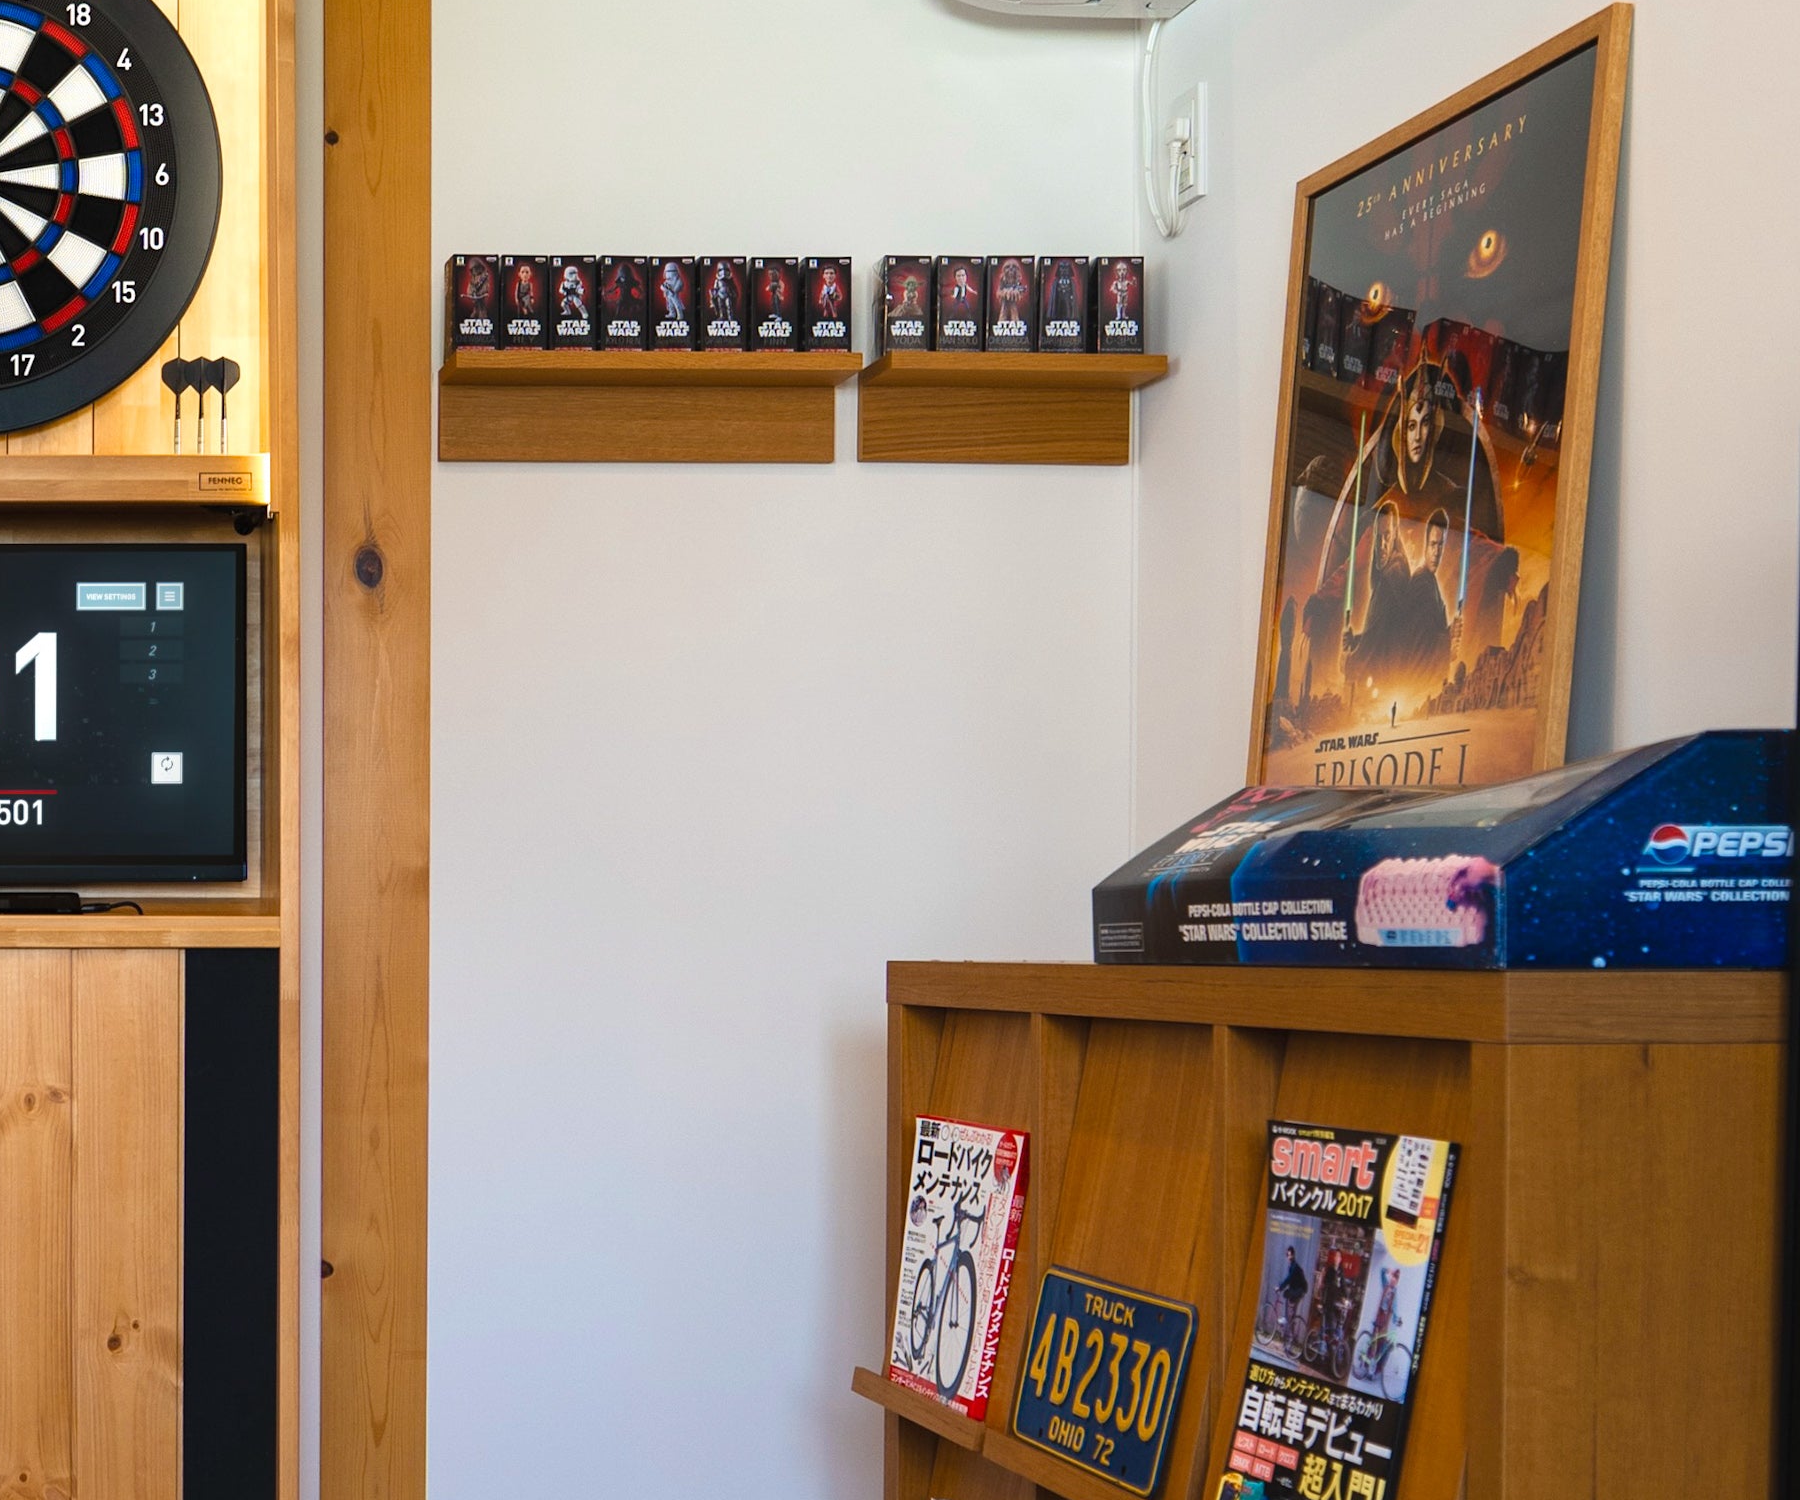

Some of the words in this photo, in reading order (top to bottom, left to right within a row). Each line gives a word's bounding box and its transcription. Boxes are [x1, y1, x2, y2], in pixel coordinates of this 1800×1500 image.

[66, 2, 91, 26] 18
[116, 47, 132, 71] 4
[139, 103, 164, 127] 13
[1388, 115, 1527, 202] ANNIVERSARY
[155, 162, 170, 186] 6
[1384, 223, 1403, 241] HAS
[1410, 218, 1416, 228] A
[1423, 182, 1487, 222] BEGINNING
[1402, 195, 1434, 220] EVERY
[1440, 179, 1468, 200] SAGA
[139, 227, 164, 251] 10
[111, 280, 136, 304] 15
[71, 323, 86, 347] 2
[890, 320, 925, 329] STAR
[890, 328, 925, 337] WARS
[943, 320, 977, 329] STAR
[943, 328, 977, 337] WARS
[1104, 319, 1139, 329] STAR
[1104, 328, 1139, 337] WARS
[10, 353, 35, 377] 17
[86, 593, 103, 601] VIEW
[104, 593, 136, 601] SETTINGS
[150, 622, 156, 633] 1
[149, 645, 157, 657] 2
[148, 669, 157, 680] 3
[1315, 739, 1346, 753] STAR
[1348, 732, 1379, 749] WARS
[1315, 747, 1443, 786] EPISODE
[1639, 879, 1698, 888] PEPSI-COLA
[1700, 879, 1736, 888] BOTTLE
[1738, 879, 1758, 887] CAP
[1188, 903, 1231, 918] PEPSI-COLA
[1232, 902, 1260, 916] BOTTLE
[1262, 901, 1279, 915] CAP
[1281, 899, 1333, 914] COLLECTION
[1711, 891, 1790, 902] COLLECTION
[1242, 922, 1309, 941] COLLECTION
[1311, 921, 1348, 940] STAGE
[920, 1120, 941, 1139] 最新
[917, 1139, 993, 1180] ロードバイク
[1272, 1137, 1378, 1190] smart
[913, 1169, 981, 1205] メンテナンス
[1272, 1181, 1336, 1212] バイシクル
[1336, 1191, 1373, 1219] 2017
[1084, 1292, 1136, 1329] TRUCK
[976, 1247, 1015, 1399] ロードバイクメンテナンス
[1029, 1312, 1171, 1443] 4B2330
[1238, 1385, 1393, 1466] 自転車デビュー
[1048, 1414, 1085, 1453] OHIO
[1093, 1433, 1116, 1467] 72
